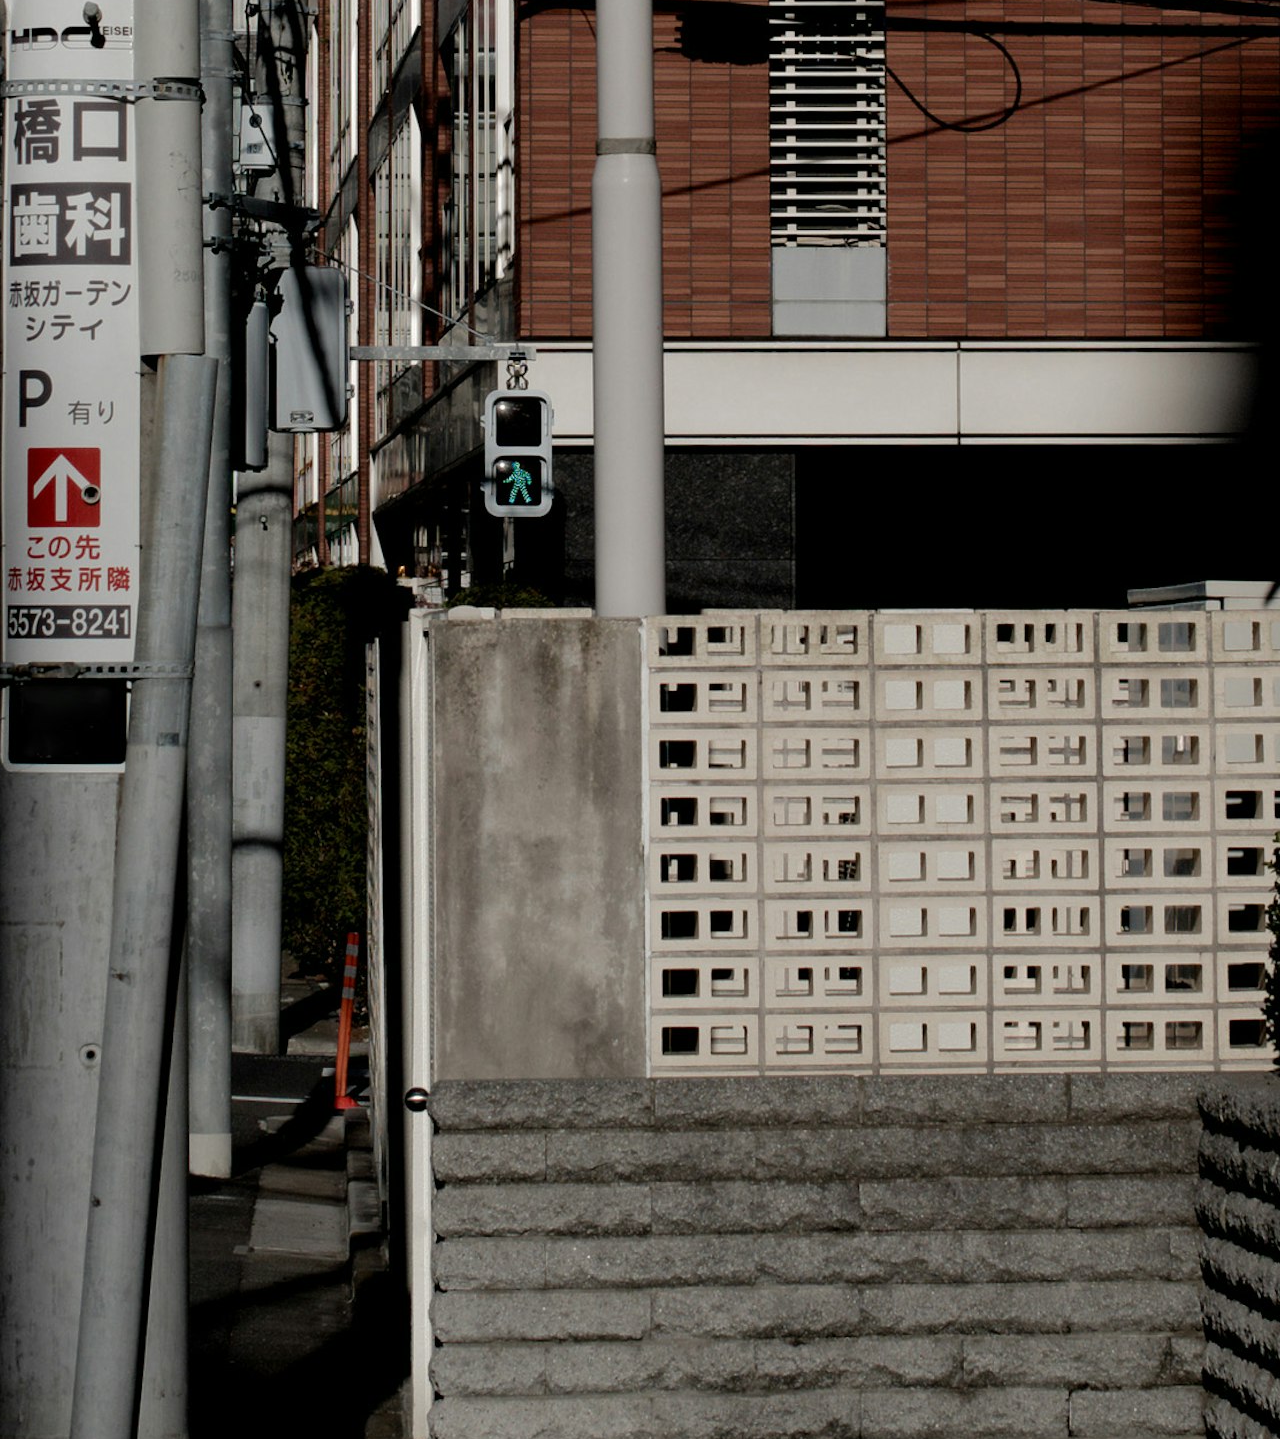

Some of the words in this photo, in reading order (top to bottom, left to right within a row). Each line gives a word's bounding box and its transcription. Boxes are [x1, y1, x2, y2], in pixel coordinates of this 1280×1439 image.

[14, 99, 128, 165] 橋口
[13, 191, 126, 257] 歯科
[9, 280, 131, 308] 赤坂ガーデン
[26, 315, 103, 342] シティ
[19, 369, 53, 428] P
[68, 400, 114, 425] 有り
[27, 534, 101, 560] この先
[8, 566, 131, 592] 赤坂支所隣
[8, 608, 130, 637] 5573-8241
